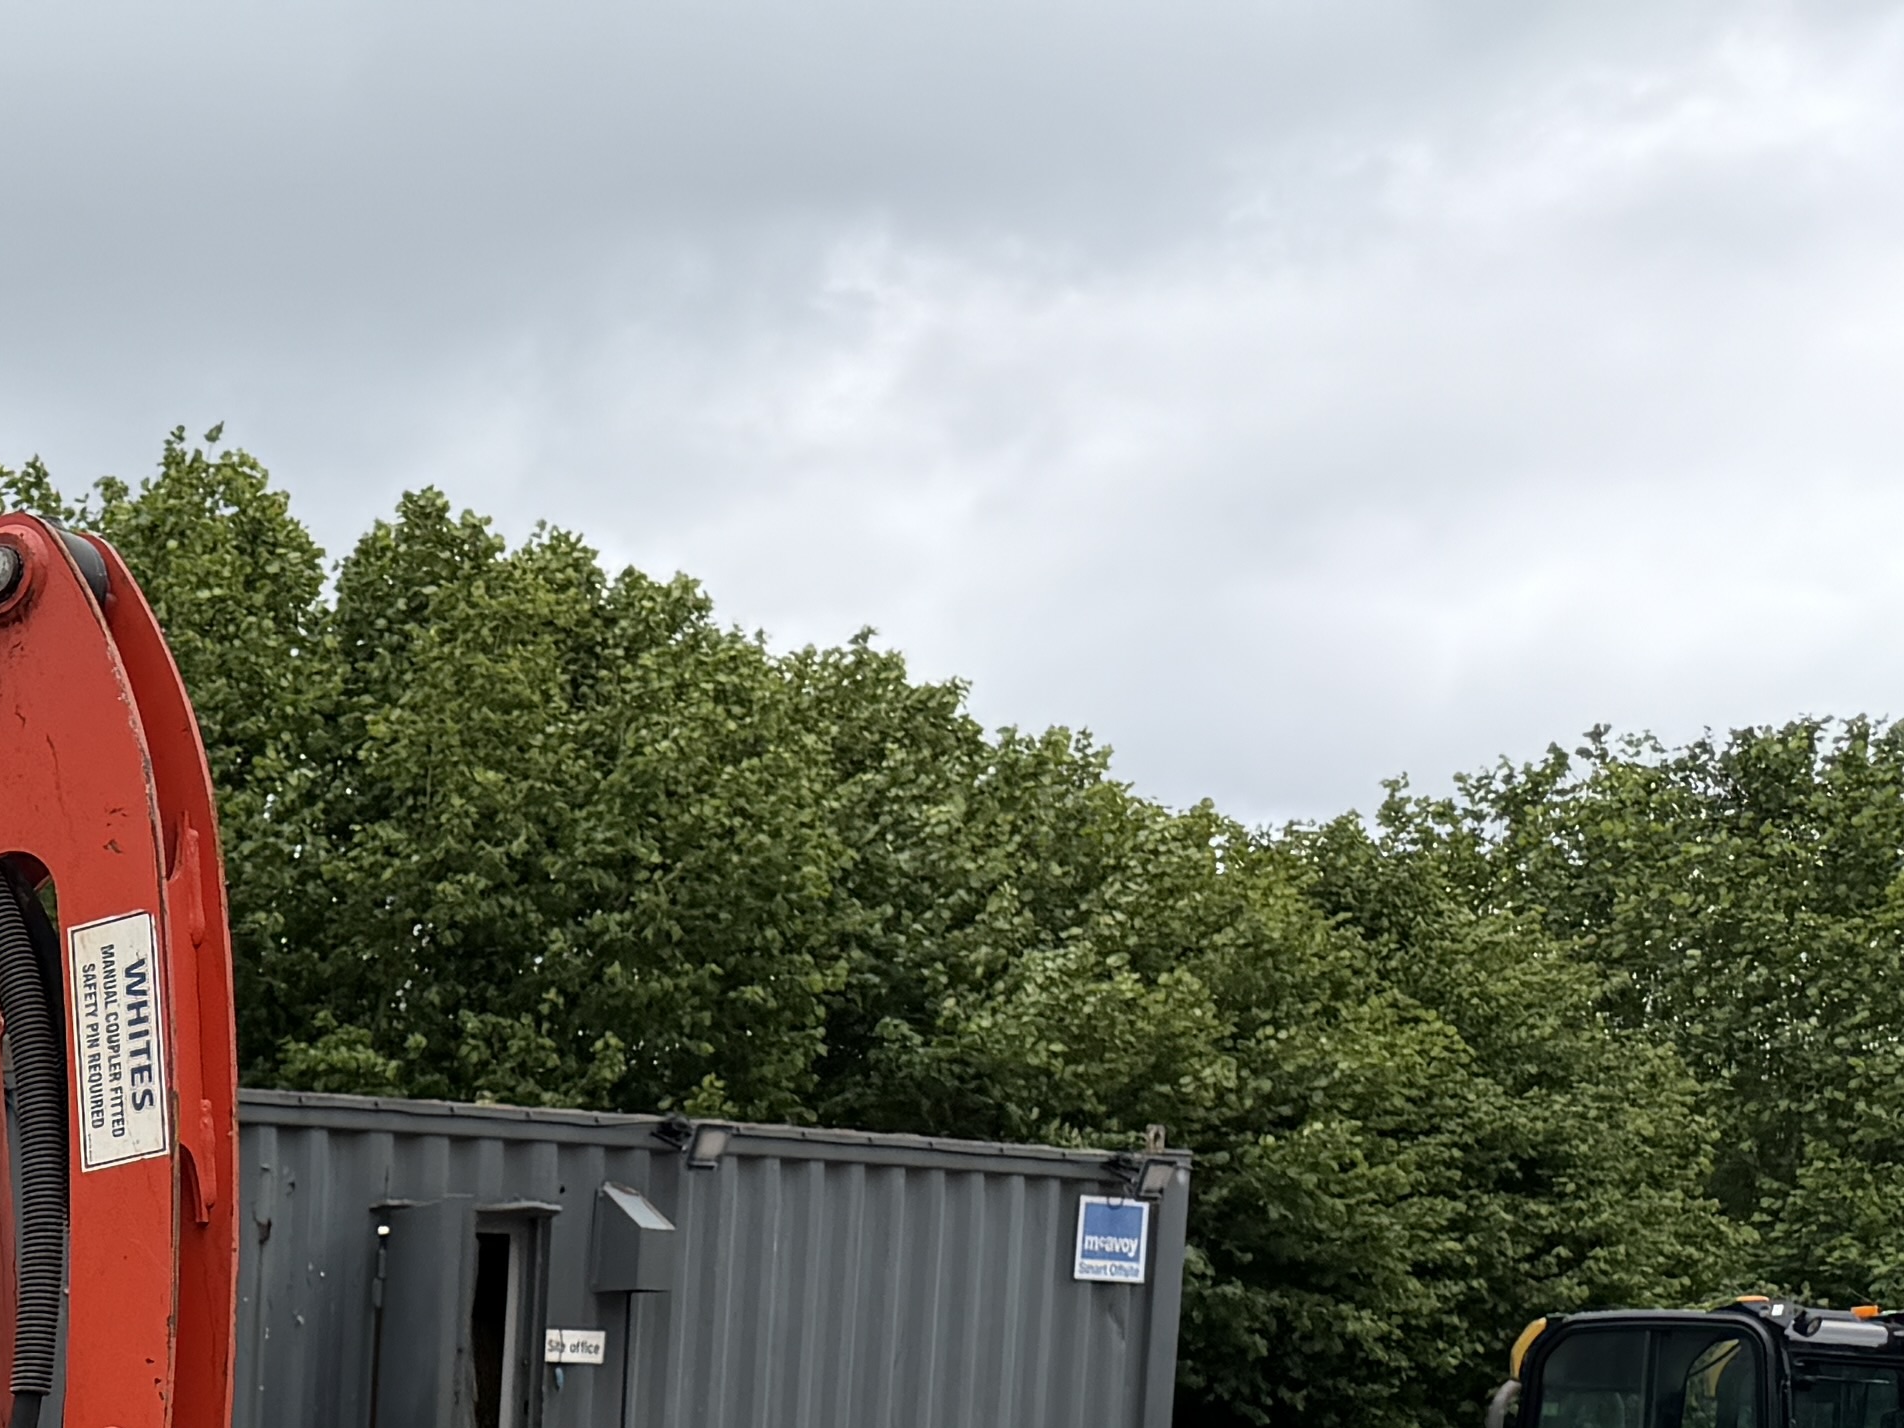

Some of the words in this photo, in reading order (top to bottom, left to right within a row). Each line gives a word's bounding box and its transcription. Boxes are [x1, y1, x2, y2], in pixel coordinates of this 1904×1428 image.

[82, 962, 98, 1018] SAFETY
[101, 943, 118, 1010] MANUAL
[86, 1022, 100, 1048] PIN
[105, 1008, 122, 1087] COUPLER
[124, 958, 154, 1112] WHITES
[88, 1052, 105, 1129] REQUIRED
[110, 1085, 125, 1138] FITTED
